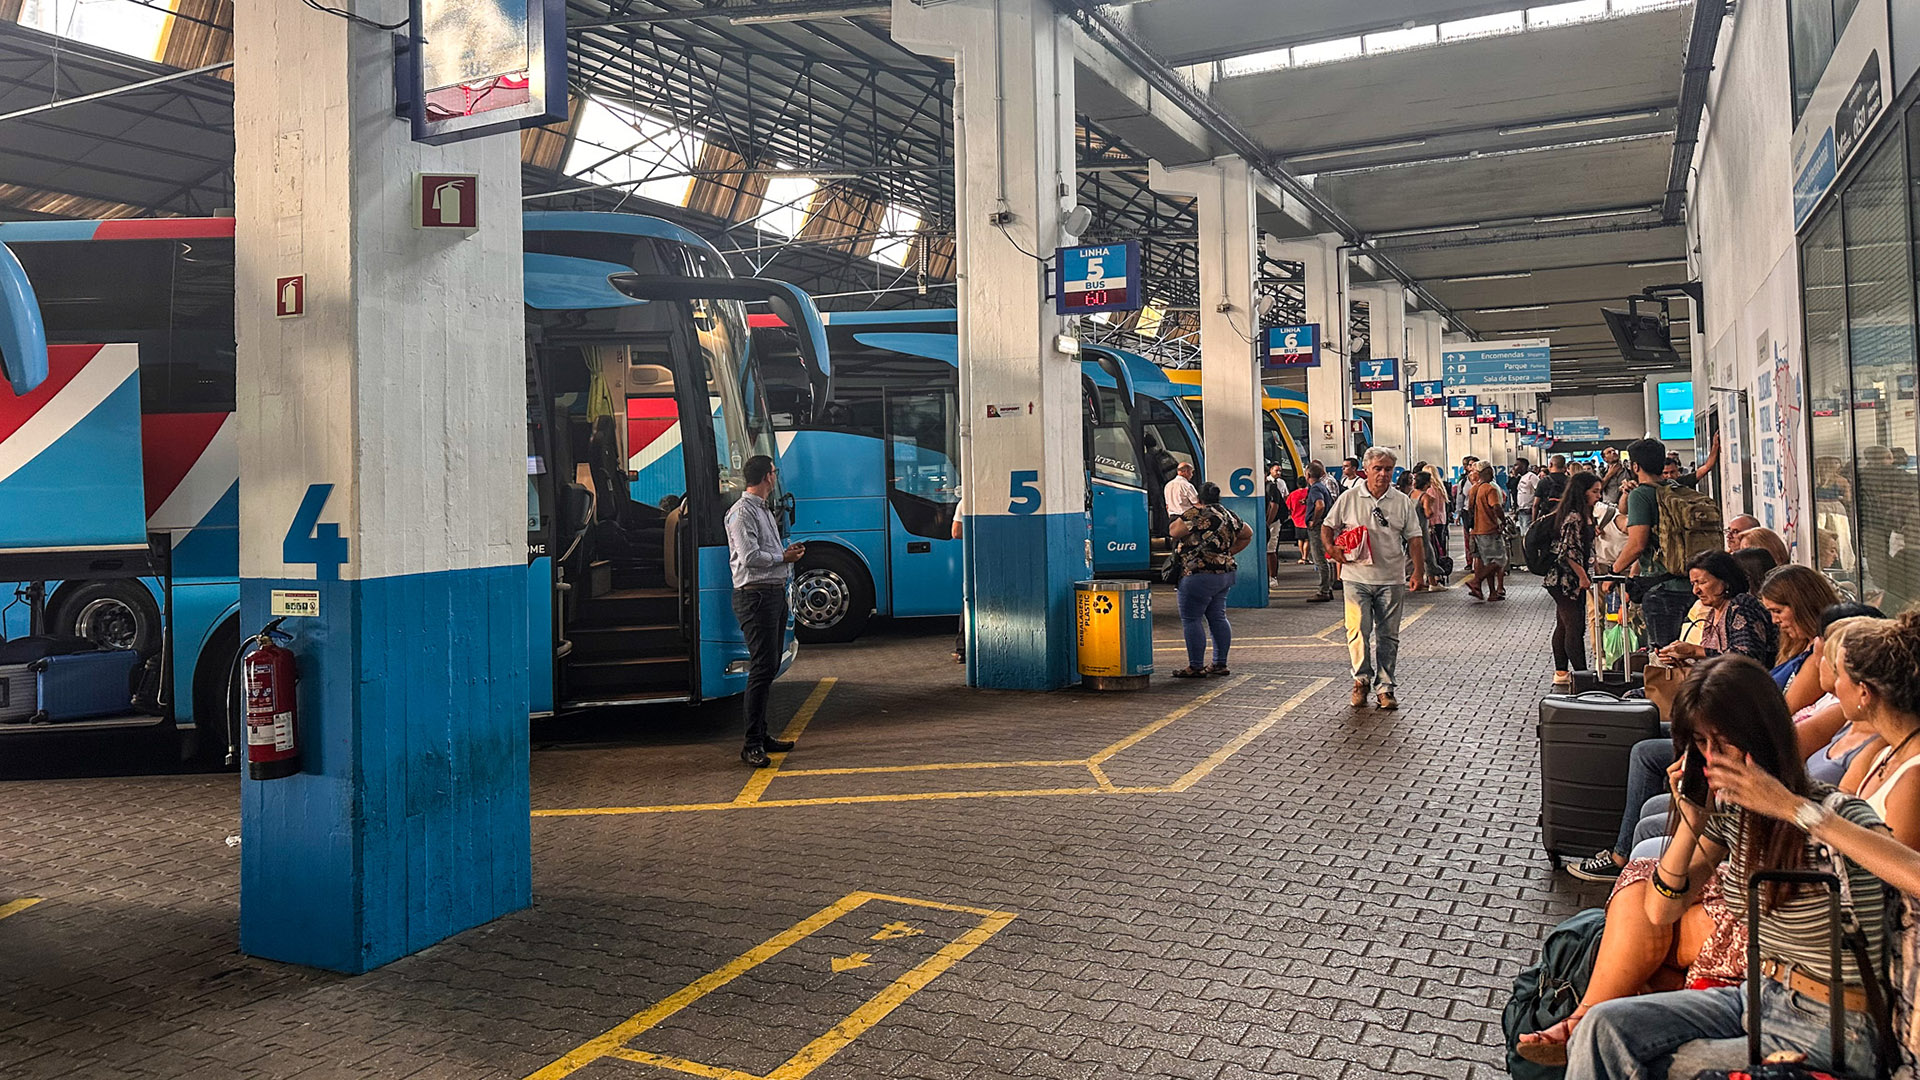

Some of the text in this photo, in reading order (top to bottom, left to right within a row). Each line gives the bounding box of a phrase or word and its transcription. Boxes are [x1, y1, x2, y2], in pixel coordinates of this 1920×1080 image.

[1080, 248, 1110, 258] LINHA
[1086, 257, 1105, 280] 5
[1085, 281, 1106, 289] BUS
[1085, 290, 1107, 306] 60
[1284, 333, 1298, 348] 6
[1481, 351, 1524, 359] Encomendas
[1371, 365, 1381, 377] 7
[1508, 374, 1530, 382] Espera
[1423, 386, 1432, 396] 8
[1458, 400, 1465, 408] 9
[1481, 408, 1492, 416] 10
[1230, 467, 1254, 497] 6
[1008, 470, 1041, 515] 5
[283, 484, 349, 580] 4
[527, 544, 546, 554] ME
[1107, 541, 1137, 551] Cura
